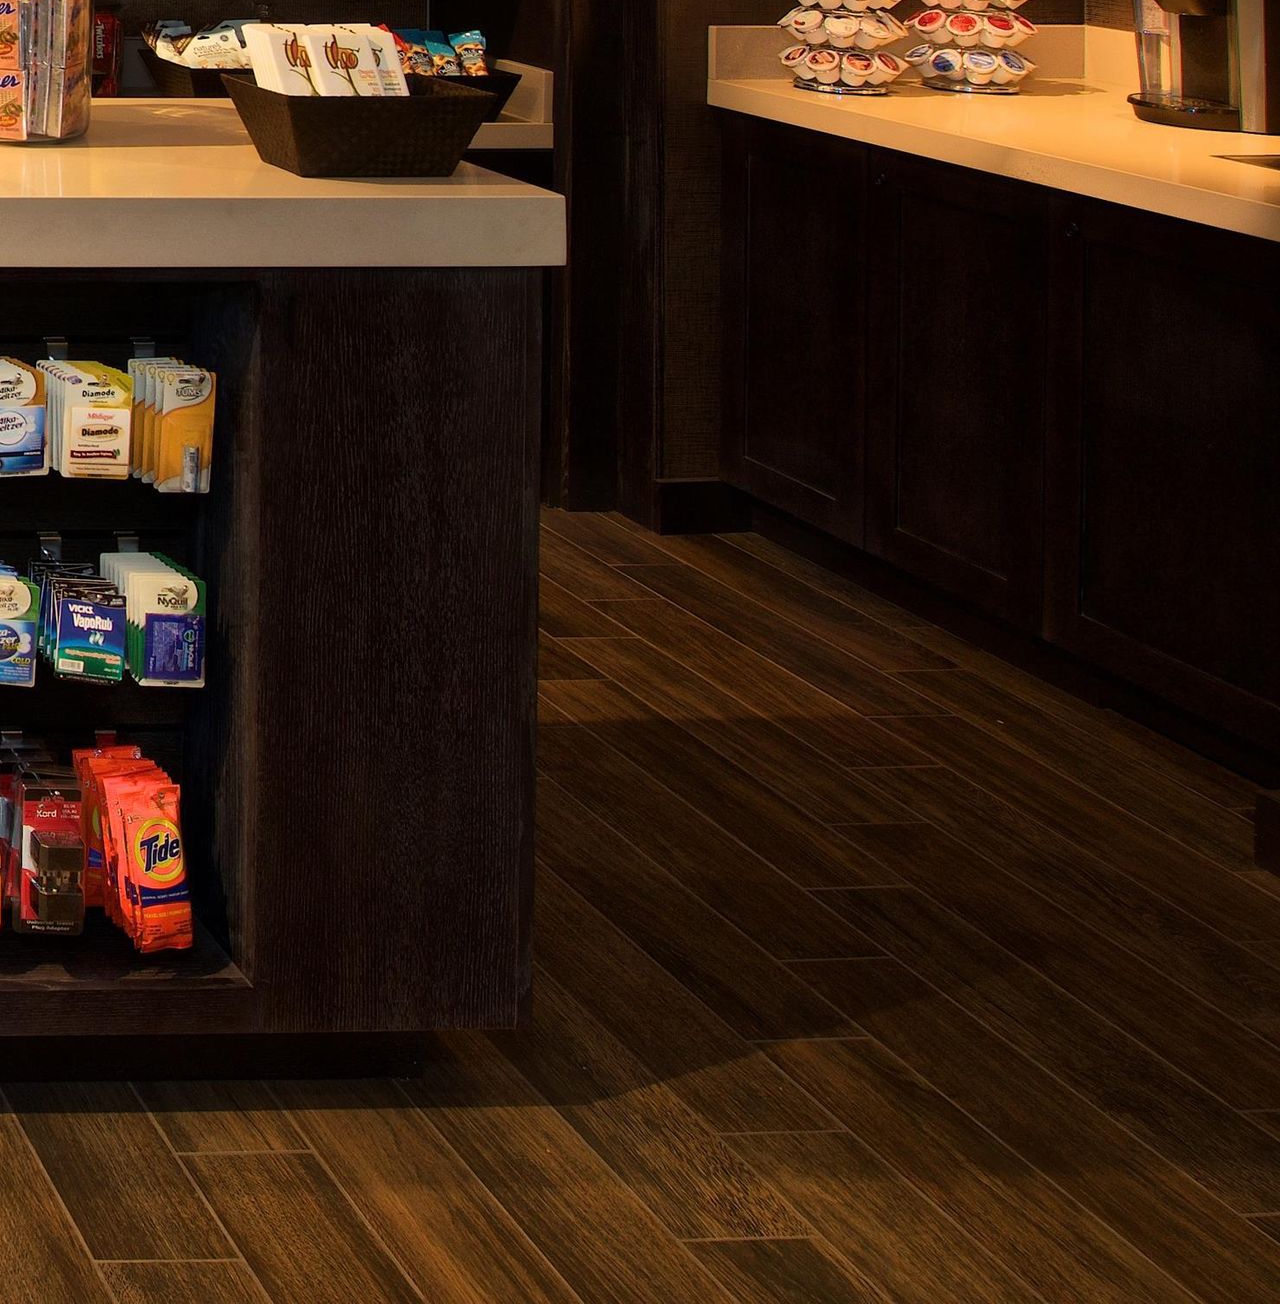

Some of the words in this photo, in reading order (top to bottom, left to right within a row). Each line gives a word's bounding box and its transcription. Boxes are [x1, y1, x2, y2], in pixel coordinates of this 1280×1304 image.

[81, 389, 116, 398] Diamode
[175, 388, 203, 397] TUMS
[81, 427, 120, 437] Diamode
[157, 597, 189, 607] NyQuil
[68, 603, 94, 614] VICKS
[73, 612, 113, 631] VapoRub
[141, 832, 180, 873] Tide
